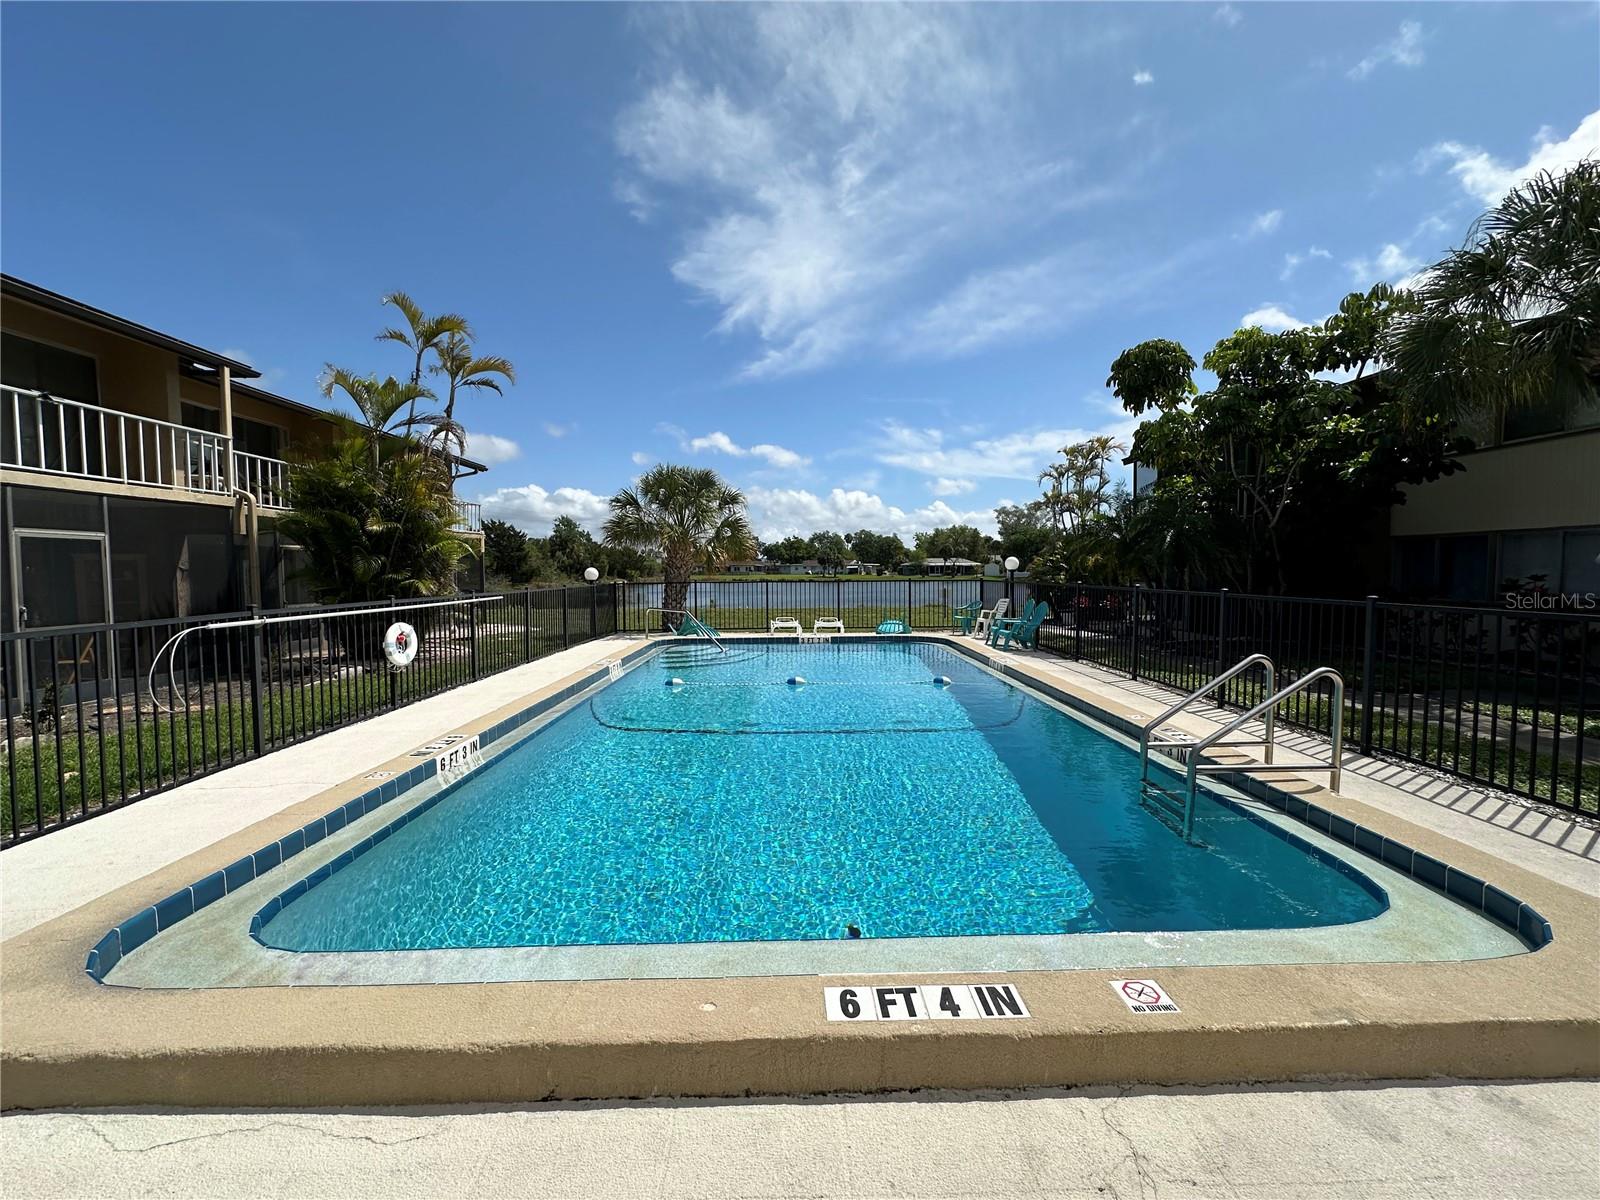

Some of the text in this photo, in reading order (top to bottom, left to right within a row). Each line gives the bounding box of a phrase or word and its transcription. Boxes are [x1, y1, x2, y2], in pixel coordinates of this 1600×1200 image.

[440, 739, 478, 772] 6 FT 3 IN
[840, 986, 1024, 1018] 6 FT 4 IN
[1146, 1004, 1178, 1012] DIVING
